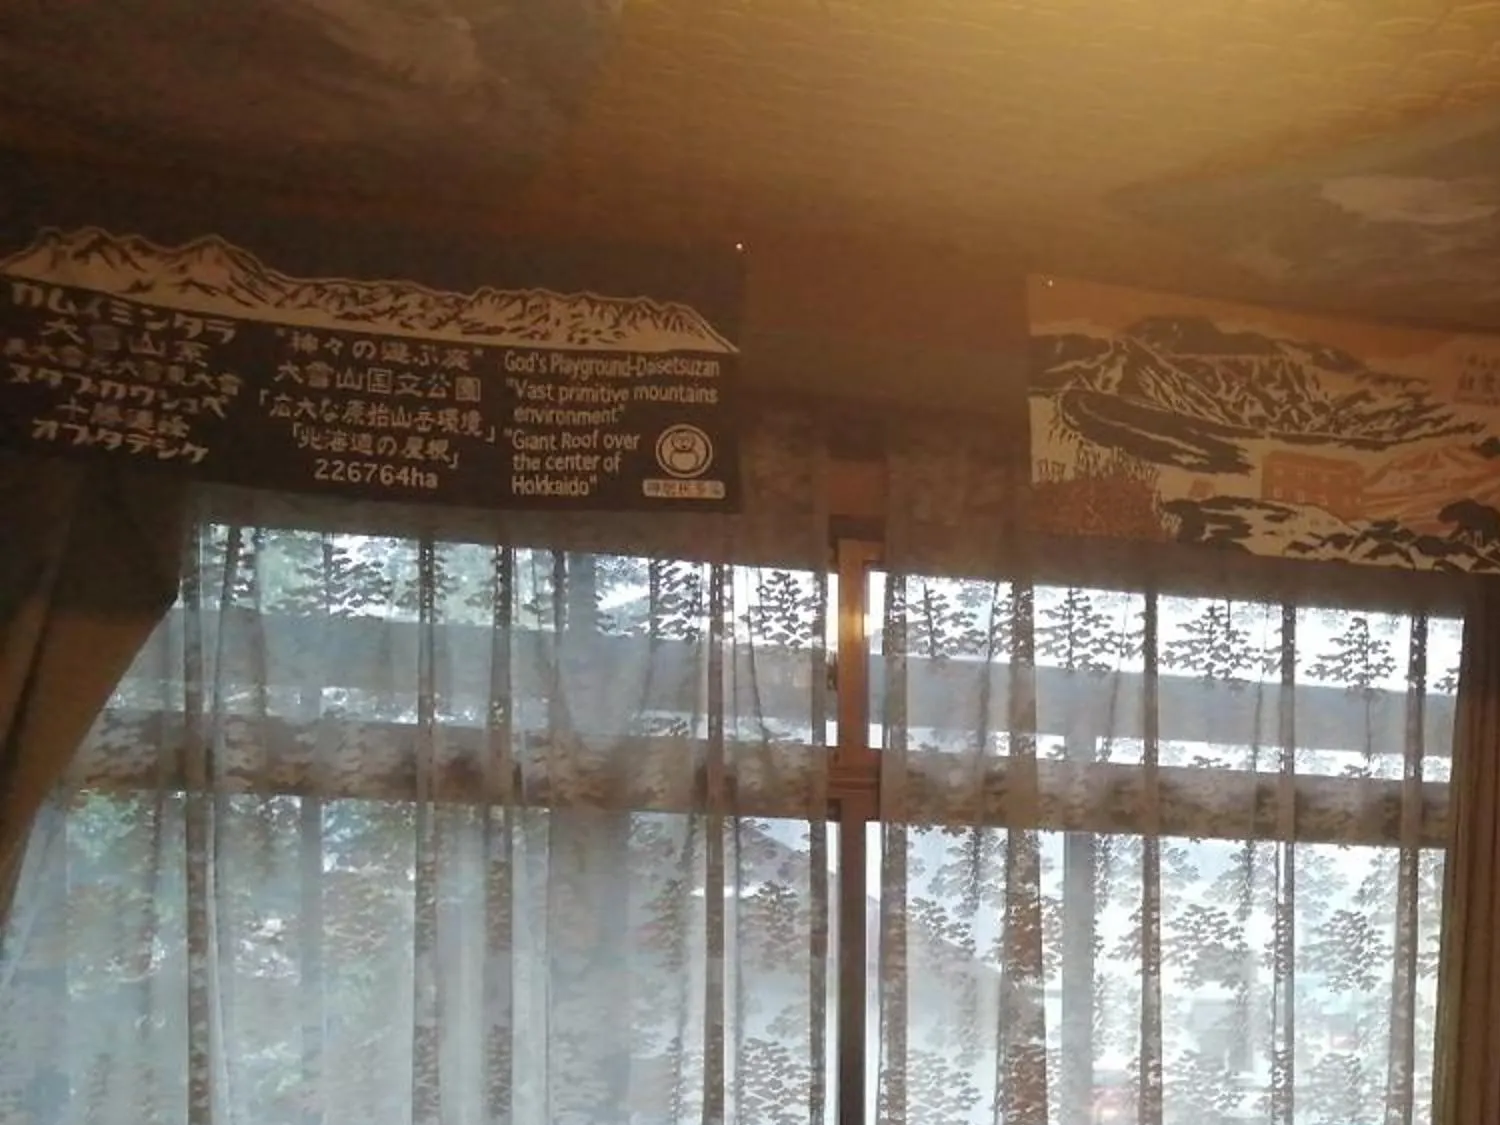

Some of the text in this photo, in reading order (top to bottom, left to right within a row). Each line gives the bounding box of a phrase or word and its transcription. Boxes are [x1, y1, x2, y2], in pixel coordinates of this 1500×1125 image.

[505, 351, 547, 373] God's
[559, 382, 629, 405] primitive
[634, 385, 718, 404] mountains
[561, 430, 598, 450] Roof
[603, 434, 641, 451] over
[314, 458, 438, 490] 226764ha
[512, 453, 621, 474] the center of
